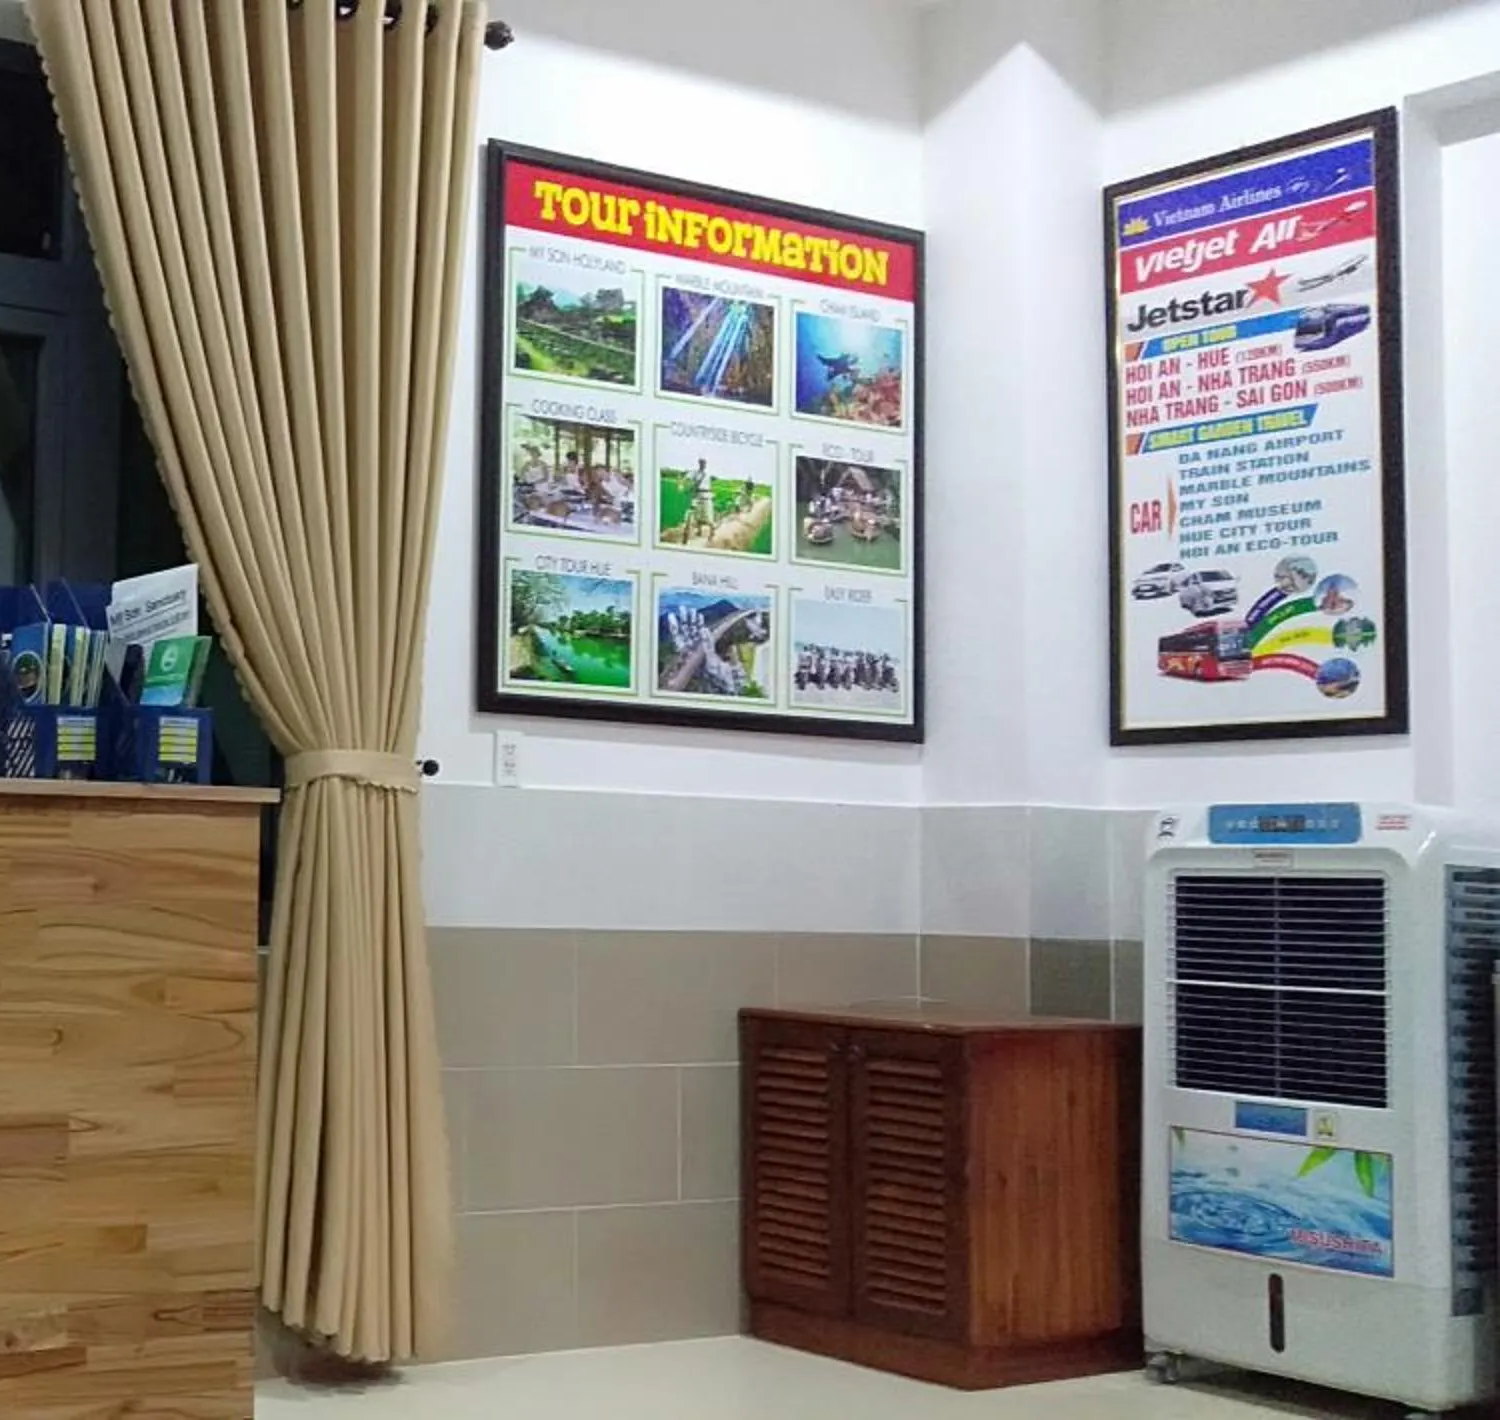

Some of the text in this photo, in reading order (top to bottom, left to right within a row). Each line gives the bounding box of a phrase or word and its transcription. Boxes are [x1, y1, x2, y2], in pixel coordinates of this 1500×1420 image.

[1153, 184, 1282, 227] Vietnam Airlines
[1250, 214, 1302, 255] Air
[1127, 288, 1248, 332] Jetstar
[1125, 363, 1152, 384] HOI
[1157, 355, 1181, 377] AN
[1197, 347, 1230, 370] HUE
[1125, 384, 1153, 407] HOI
[1157, 378, 1181, 400] AN
[1199, 371, 1233, 393] NHA
[1238, 358, 1296, 385] TRANG
[531, 399, 617, 424] COOKING CLASS
[1125, 406, 1160, 428] NHA
[1166, 396, 1219, 420] TRANG
[1237, 386, 1265, 410] SAI
[1271, 379, 1307, 401] GON
[1206, 443, 1258, 461] NANG
[1264, 430, 1344, 456] AIRPORT
[1179, 451, 1309, 480] TRAIN STATION
[1179, 460, 1372, 496] MARBLE MOUNTAINS
[1130, 500, 1162, 534] CAR
[1179, 500, 1322, 528] CHAM MUSEUM
[1180, 493, 1249, 512] MY SON
[1180, 518, 1312, 544] HUE CITY TOUR
[1180, 532, 1338, 559] HOI AN ECO-TOUR
[534, 554, 613, 577] CITY TOUR HUE
